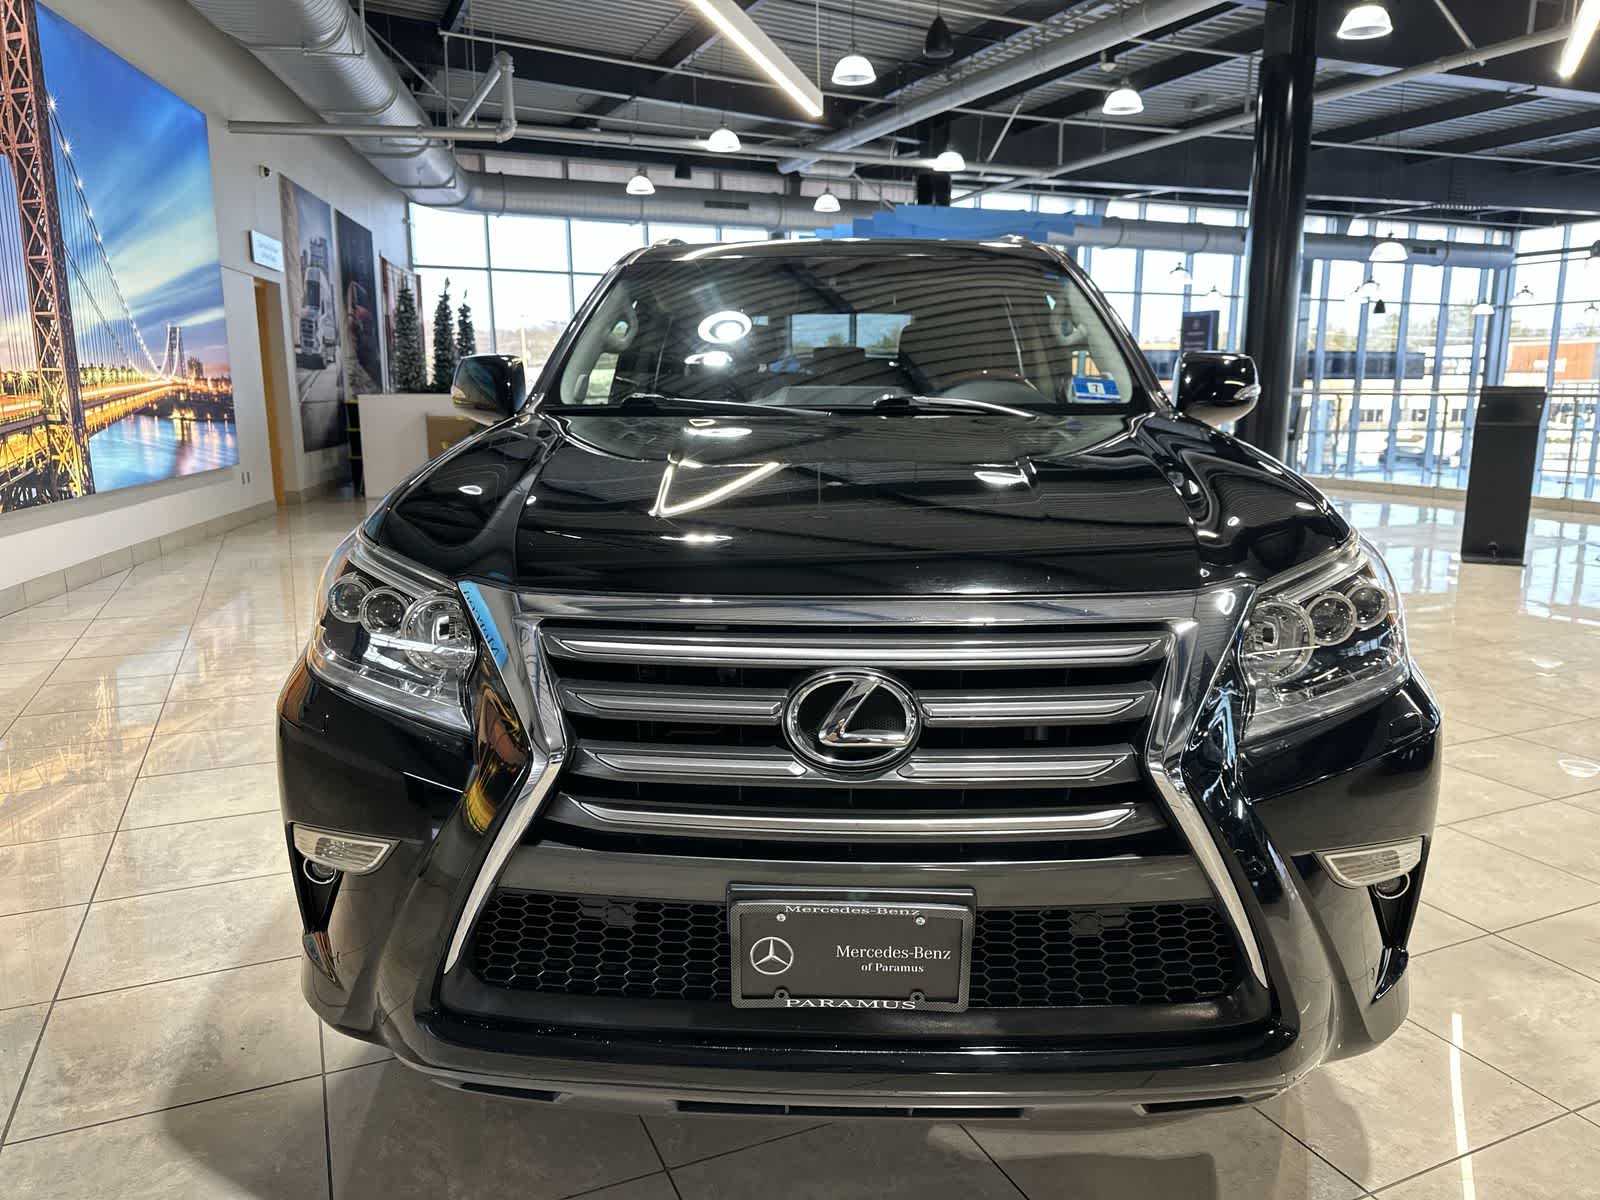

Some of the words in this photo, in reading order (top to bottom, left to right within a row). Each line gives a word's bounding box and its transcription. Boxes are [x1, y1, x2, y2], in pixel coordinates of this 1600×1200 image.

[785, 905, 921, 916] Mercedes-Benz
[836, 945, 952, 960] Mercedes-Benz
[861, 963, 873, 972] of
[875, 963, 925, 974] Paramus
[785, 999, 917, 1010] PARAMUS
